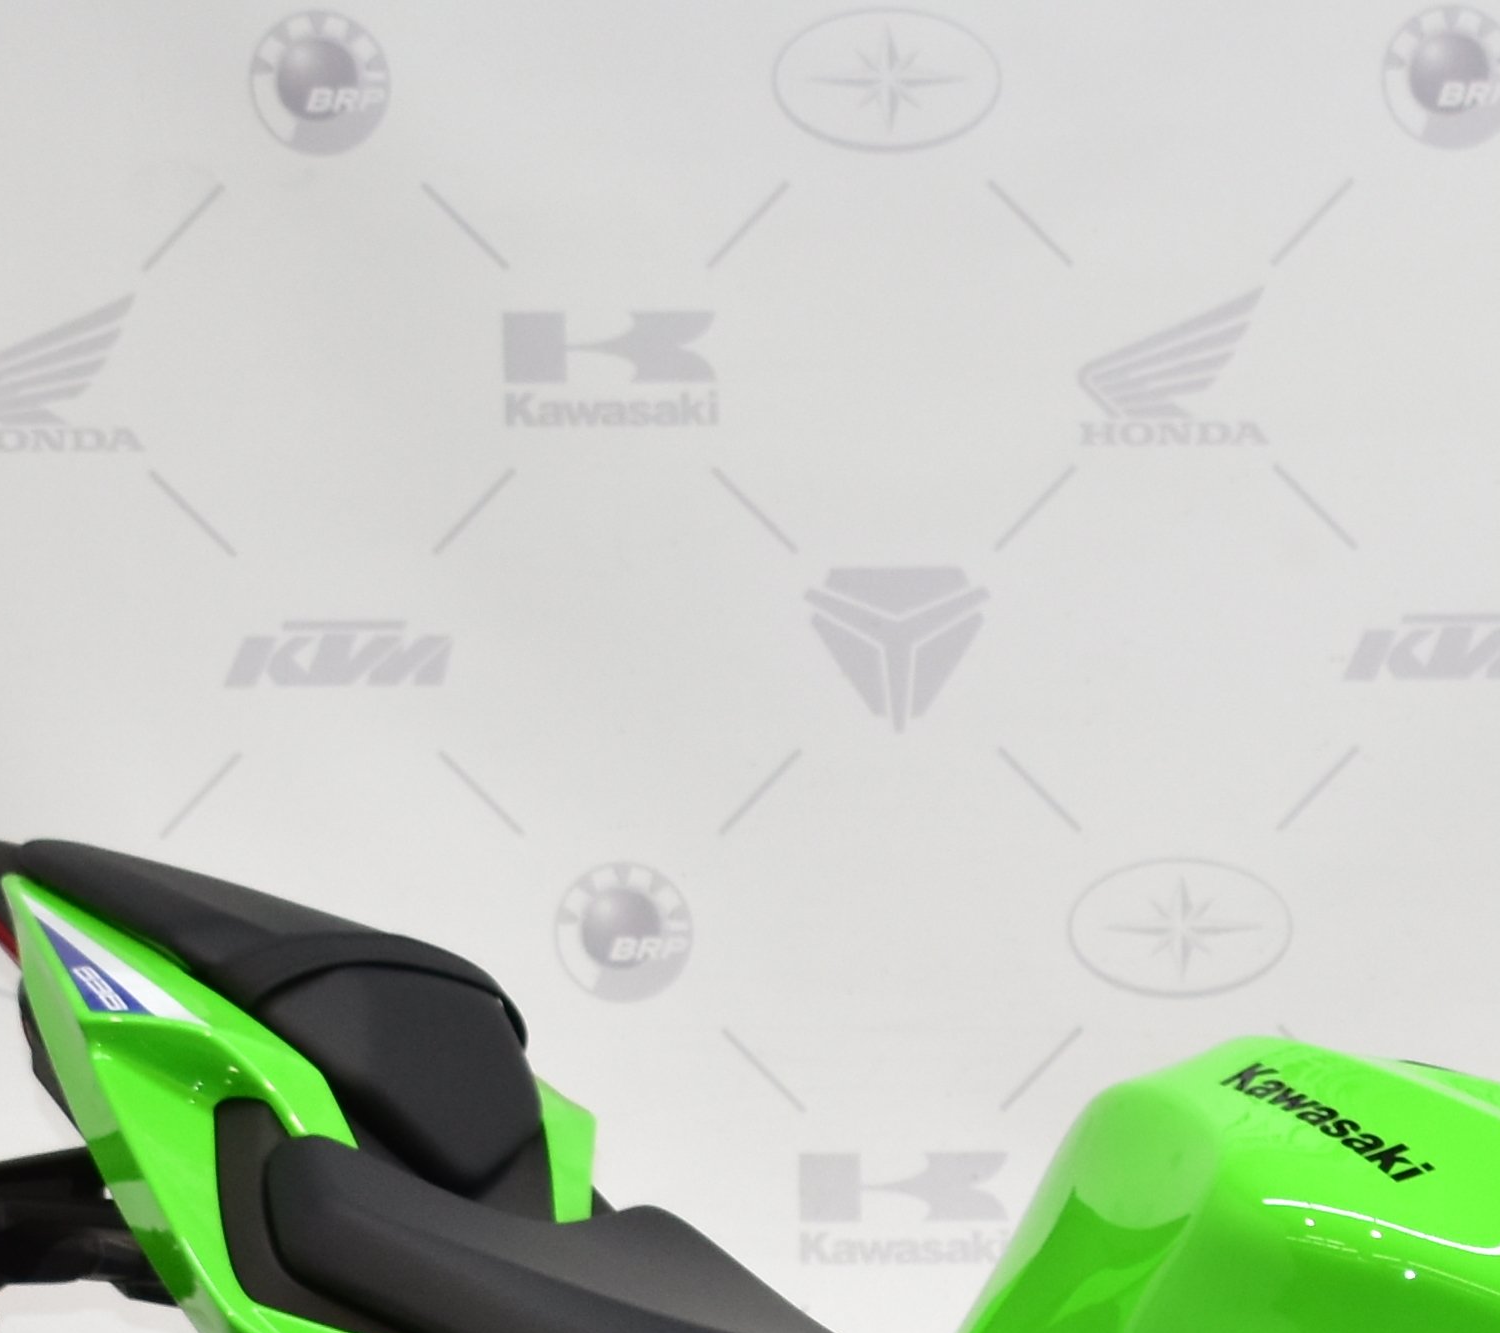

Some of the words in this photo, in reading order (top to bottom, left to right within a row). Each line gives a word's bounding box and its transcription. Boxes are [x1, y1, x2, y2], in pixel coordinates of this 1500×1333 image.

[306, 87, 384, 112] BRP
[503, 392, 718, 427] Kawasaki
[1079, 421, 1269, 447] HONDA
[224, 620, 453, 688] KTM
[609, 937, 688, 962] BRP
[1219, 1063, 1435, 1182] Kawasaki
